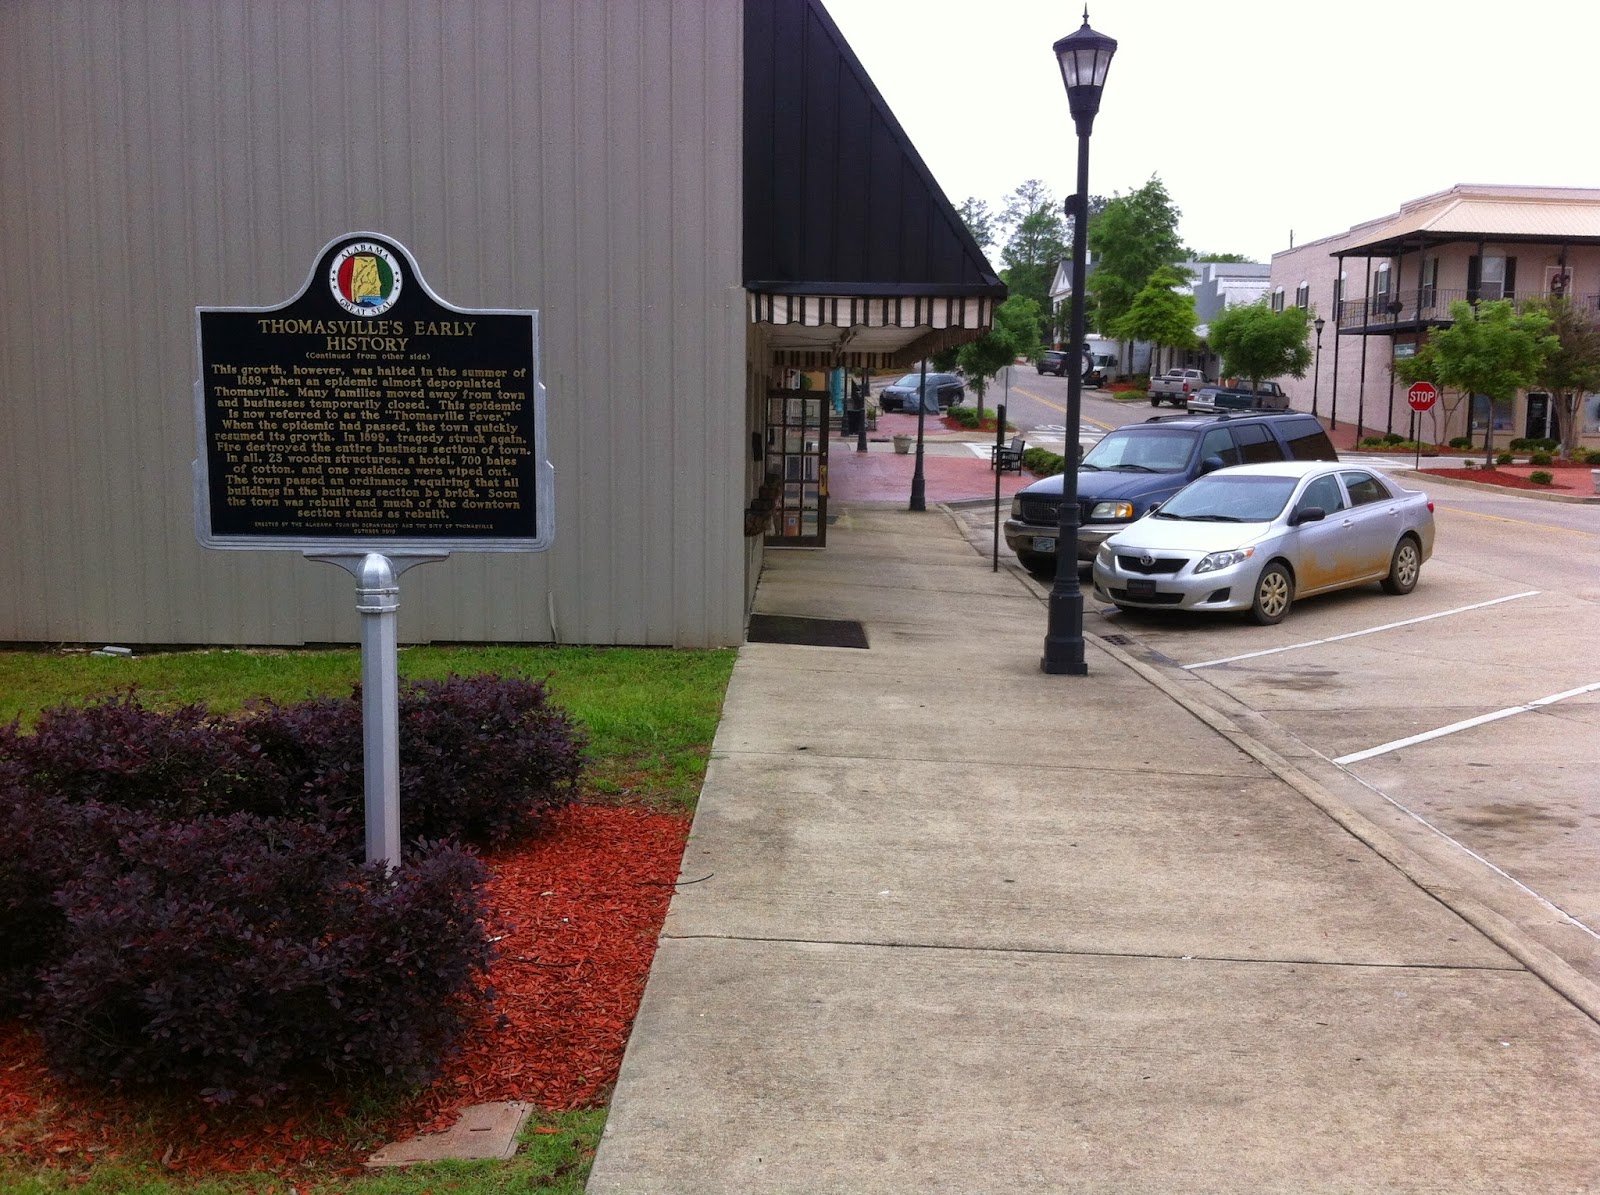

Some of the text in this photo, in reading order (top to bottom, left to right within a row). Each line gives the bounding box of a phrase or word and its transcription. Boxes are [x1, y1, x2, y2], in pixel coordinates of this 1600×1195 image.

[341, 244, 389, 260] ALABAMA
[339, 298, 393, 315] GREAT SEAL
[258, 319, 476, 336] THOMASVILLE'S EARLY
[326, 336, 409, 352] HISTORY
[306, 352, 351, 360] (Continued
[410, 353, 430, 361] side)
[211, 364, 237, 374] This
[241, 364, 287, 377] growth,
[293, 365, 345, 376] however,
[377, 366, 416, 376] halted
[421, 366, 433, 376] in
[436, 367, 457, 376] the
[462, 369, 507, 377] summer
[513, 367, 526, 377] of
[272, 376, 301, 386] when
[306, 378, 320, 386] an
[325, 376, 377, 389] epidemic
[382, 377, 422, 387] almost
[427, 377, 501, 390] depopulated
[214, 386, 525, 401] Thomasville. Many families moved away from town
[1409, 391, 1435, 403] STOP
[217, 397, 521, 413] and businesses temporarily closed. This epidemic
[229, 408, 239, 418] is
[270, 409, 321, 419] referred
[325, 409, 338, 419] to
[360, 410, 380, 420] the
[222, 419, 254, 429] When
[258, 420, 278, 429] the
[282, 420, 334, 433] epidemic
[339, 421, 361, 430] had
[415, 422, 436, 431] the
[440, 422, 468, 432] town
[474, 422, 518, 435] quickly
[215, 431, 264, 441] resumed
[269, 431, 285, 441] its
[289, 432, 335, 444] growth.
[344, 432, 355, 442] In
[397, 433, 444, 445] tragedy
[449, 433, 485, 443] struck
[491, 434, 527, 446] again.
[217, 441, 531, 455] Fire destroyed the entire business section of town.
[227, 453, 238, 462] In
[269, 453, 283, 463] 23
[288, 453, 331, 463] wooden
[461, 455, 481, 465] 700
[486, 456, 517, 465] bales
[233, 464, 247, 473] of
[302, 464, 323, 474] and
[354, 465, 411, 475] residence
[448, 466, 483, 478] wiped
[488, 467, 511, 476] out.
[225, 475, 248, 484] The
[252, 475, 281, 484] town
[286, 475, 325, 487] passed
[349, 476, 408, 486] ordinance
[414, 477, 470, 489] requiring
[475, 478, 499, 487] that
[504, 478, 519, 487] all
[227, 485, 517, 498] buildings in the business section be brick. Soon
[227, 496, 246, 505] the
[251, 497, 279, 506] town
[309, 497, 350, 507] rebuilt
[356, 498, 376, 507] and
[383, 498, 413, 507] much
[418, 499, 432, 508] of
[437, 499, 456, 508] the
[462, 499, 520, 509] downtown
[298, 508, 341, 517] section
[346, 508, 383, 518] stands
[405, 509, 449, 519] rebuilt.
